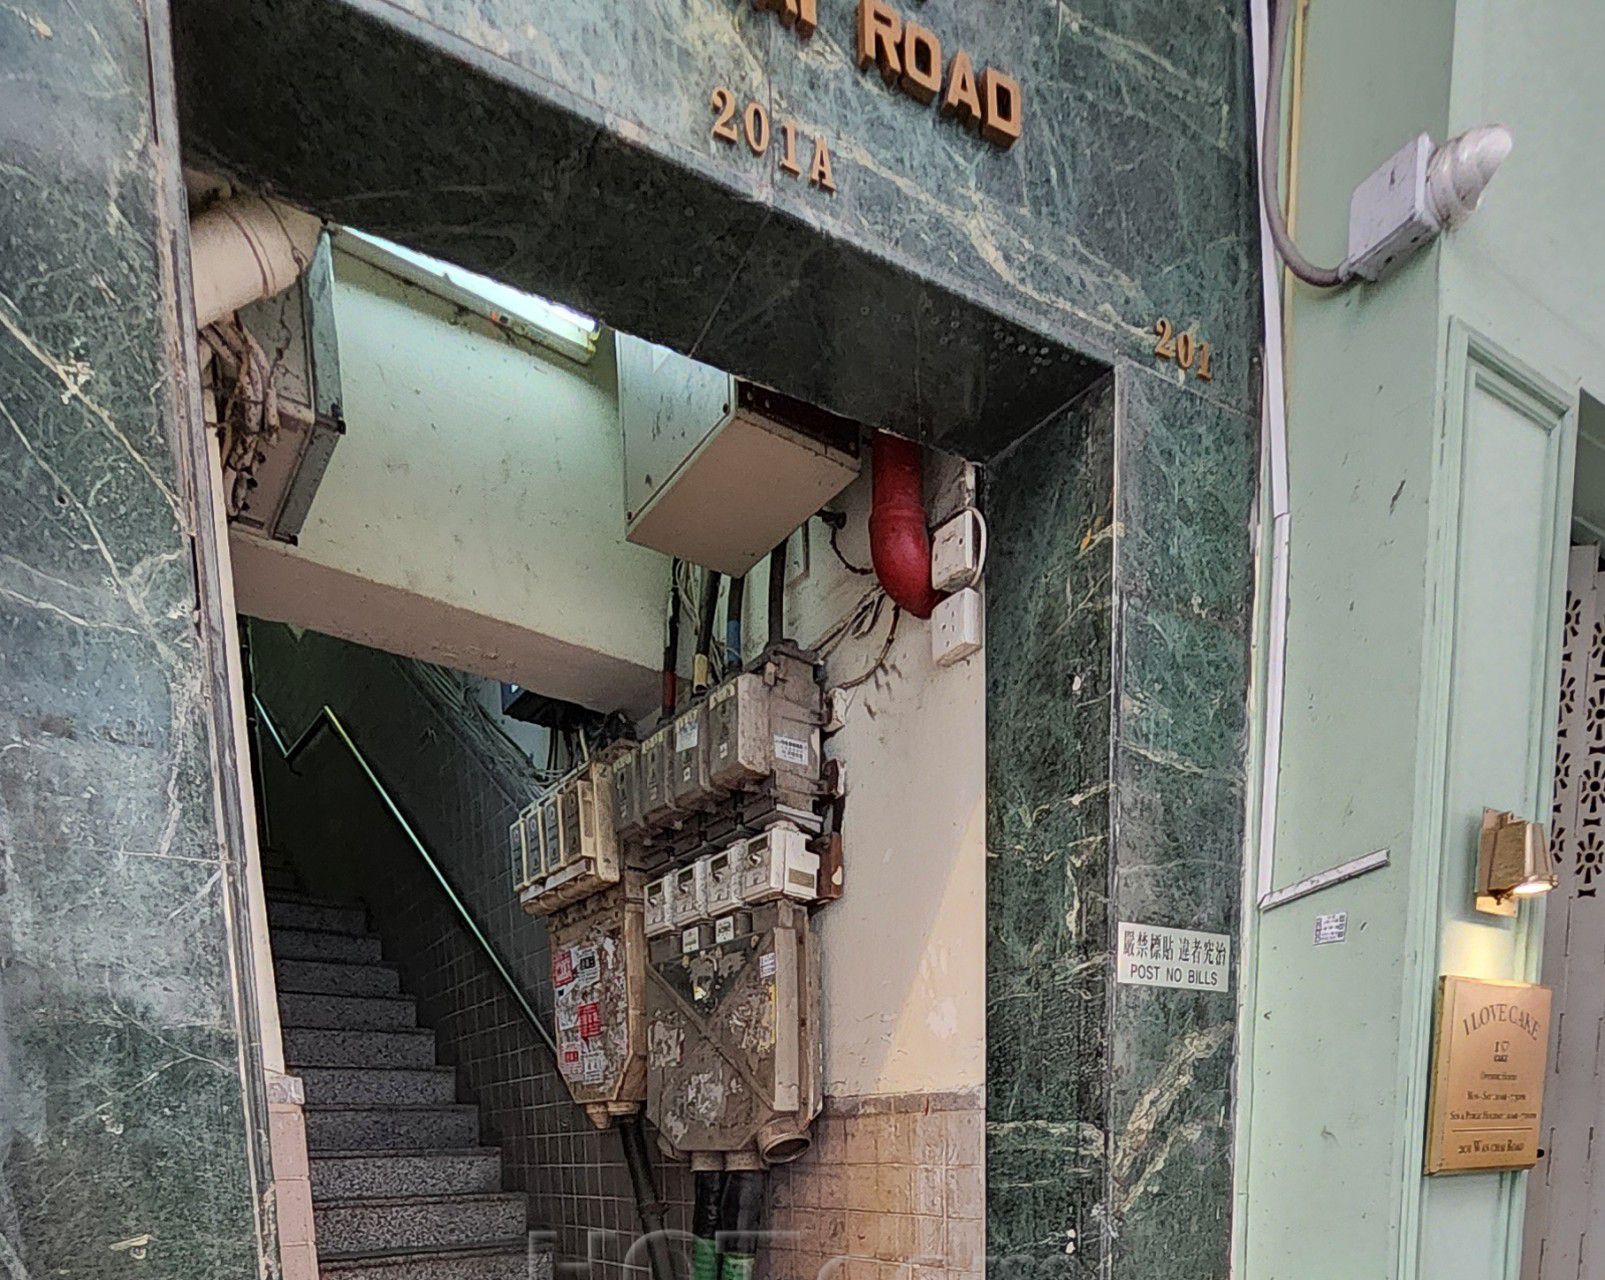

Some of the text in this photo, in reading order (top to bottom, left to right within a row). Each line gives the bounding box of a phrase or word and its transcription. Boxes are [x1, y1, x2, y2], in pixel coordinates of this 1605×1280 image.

[856, 0, 1021, 150] ROAD
[712, 87, 837, 194] 201A
[1153, 317, 1213, 384] 201
[1131, 963, 1218, 986] POST NO BILLS
[1471, 1003, 1508, 1031] LOVE
[1509, 1005, 1541, 1041] CAKE
